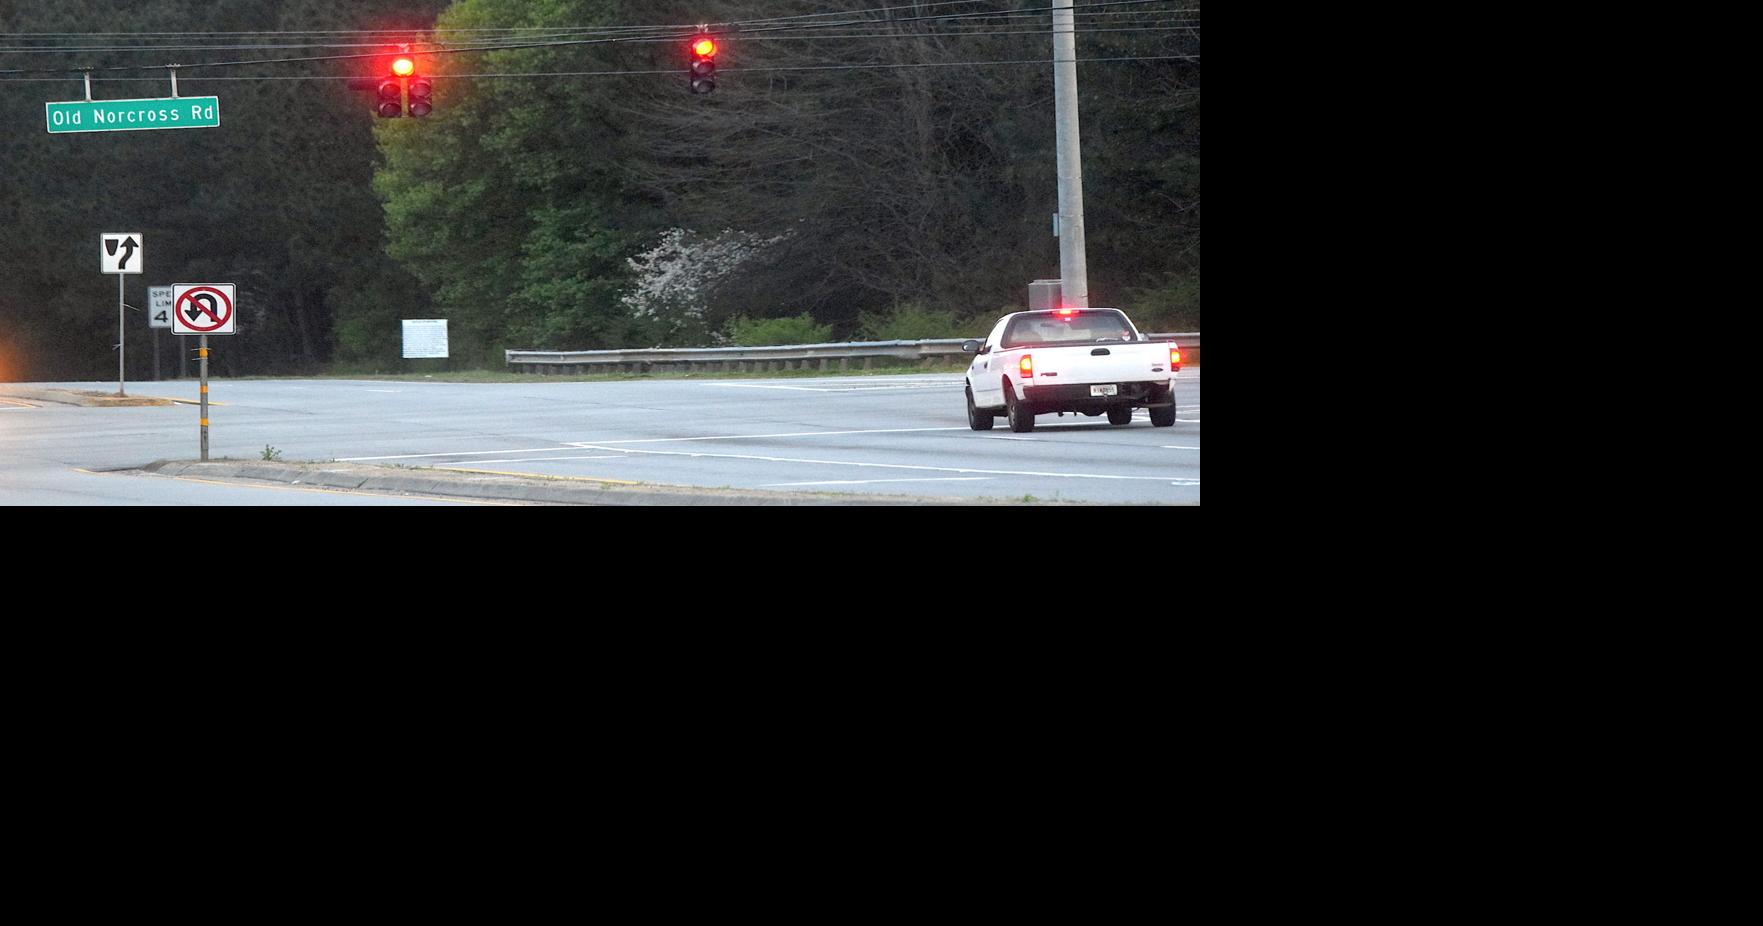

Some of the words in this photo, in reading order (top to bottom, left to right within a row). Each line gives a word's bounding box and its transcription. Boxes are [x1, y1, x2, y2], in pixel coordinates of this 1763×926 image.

[52, 110, 81, 126] Old
[93, 108, 180, 124] Norcross
[191, 105, 213, 120] Rd
[152, 290, 171, 298] SPE
[155, 300, 171, 308] LIM
[154, 310, 169, 323] 4
